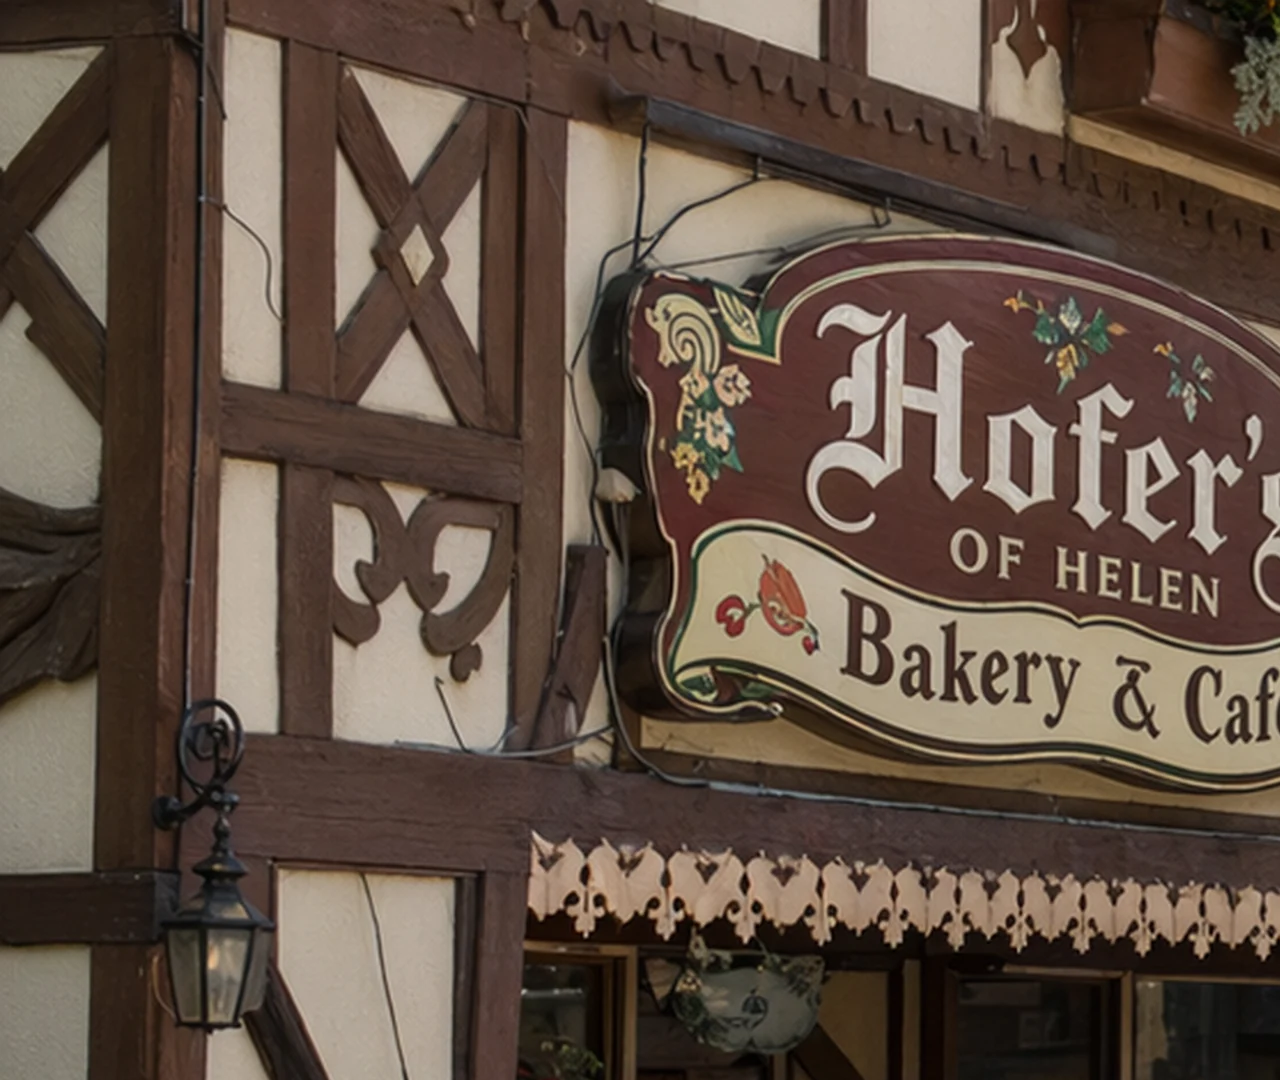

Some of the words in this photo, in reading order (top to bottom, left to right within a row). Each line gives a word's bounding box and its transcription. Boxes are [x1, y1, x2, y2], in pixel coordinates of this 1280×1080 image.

[949, 529, 1023, 582] OF
[1055, 547, 1221, 619] HELEN
[839, 589, 1082, 729] Bakery
[1114, 655, 1161, 739] &
